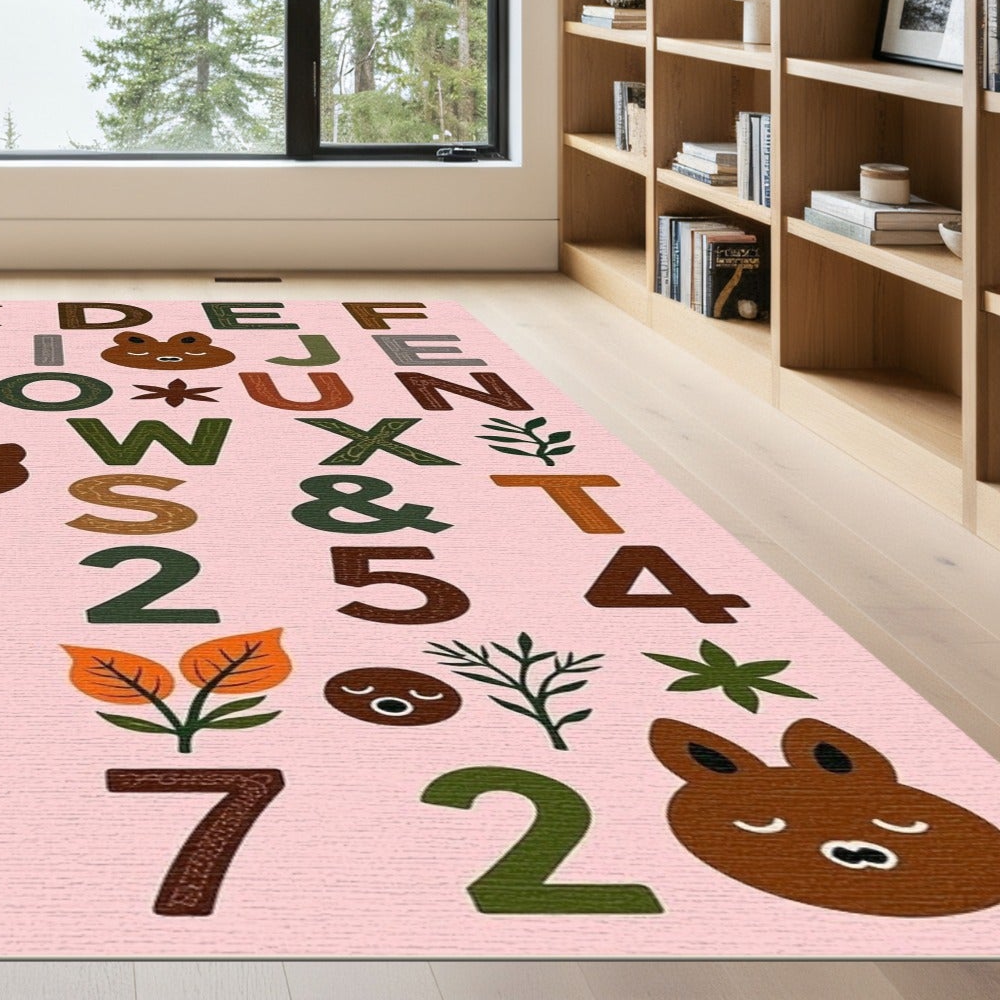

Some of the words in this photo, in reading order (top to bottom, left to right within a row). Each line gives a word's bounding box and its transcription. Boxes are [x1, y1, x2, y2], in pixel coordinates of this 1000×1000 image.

[57, 302, 153, 330] D
[201, 302, 300, 330] E
[341, 302, 428, 330] F
[265, 334, 341, 367] J
[371, 334, 488, 367] E
[238, 371, 354, 411] U
[394, 371, 534, 411] N
[66, 417, 232, 466] W
[294, 417, 462, 466] X
[65, 474, 198, 535] S
[291, 474, 455, 535] &
[489, 474, 625, 535] T
[79, 545, 221, 625] 2
[329, 545, 471, 625] 5
[584, 545, 751, 625] 4
[105, 767, 285, 917] 7
[420, 766, 665, 915] 2
